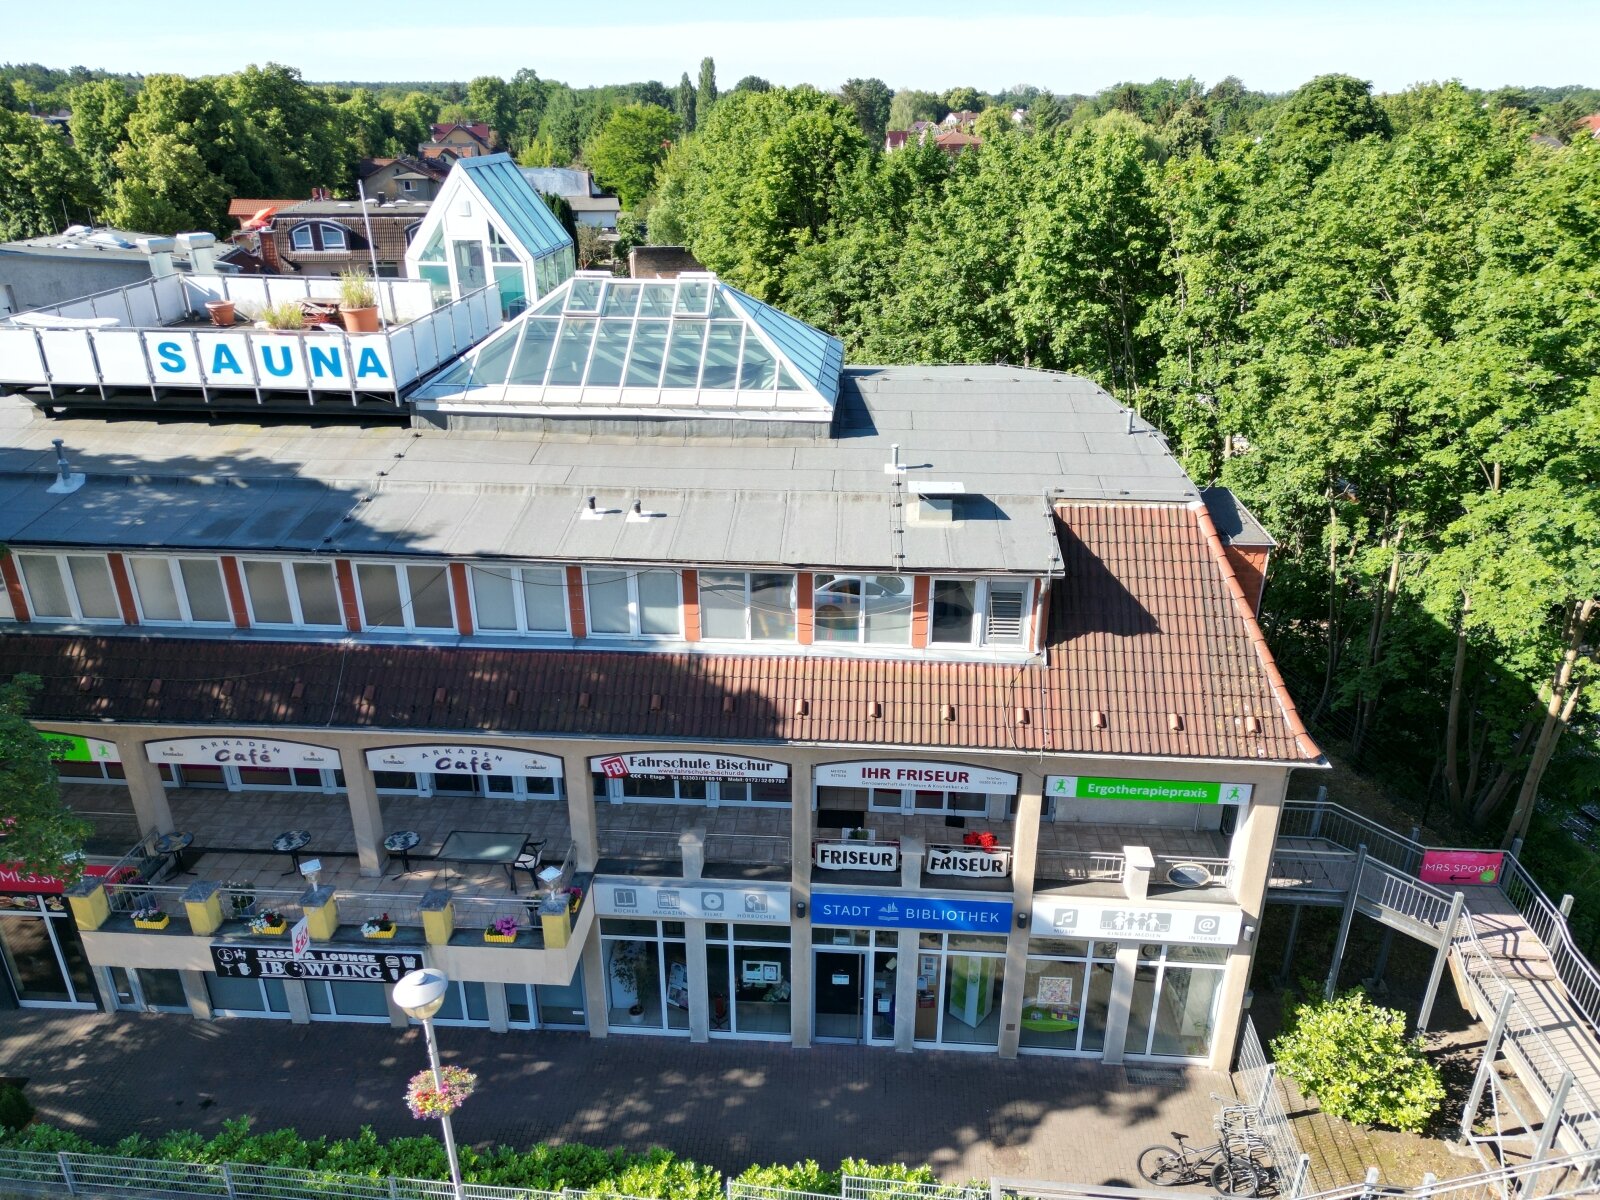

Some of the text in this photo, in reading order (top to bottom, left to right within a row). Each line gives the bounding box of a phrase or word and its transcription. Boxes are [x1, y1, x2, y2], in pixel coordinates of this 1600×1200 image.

[157, 341, 389, 379] SAUNA
[200, 740, 280, 754] ARKADEN
[214, 749, 272, 765] Café
[421, 749, 503, 762] ARKADEN
[435, 757, 492, 773] Café
[603, 761, 625, 777] FB
[629, 756, 773, 771] Fahrschule Bischur
[657, 768, 745, 776] www.fahrschule-bischur.de
[862, 768, 970, 783] IHR FRISEUR
[1088, 783, 1208, 798] Ergotherapiepraxis
[820, 850, 893, 867] FRISEUR
[930, 857, 1003, 873] FRISEUR
[823, 904, 999, 923] STADT BIBLIOTHEK
[257, 950, 376, 963] PASCA LOUNGE
